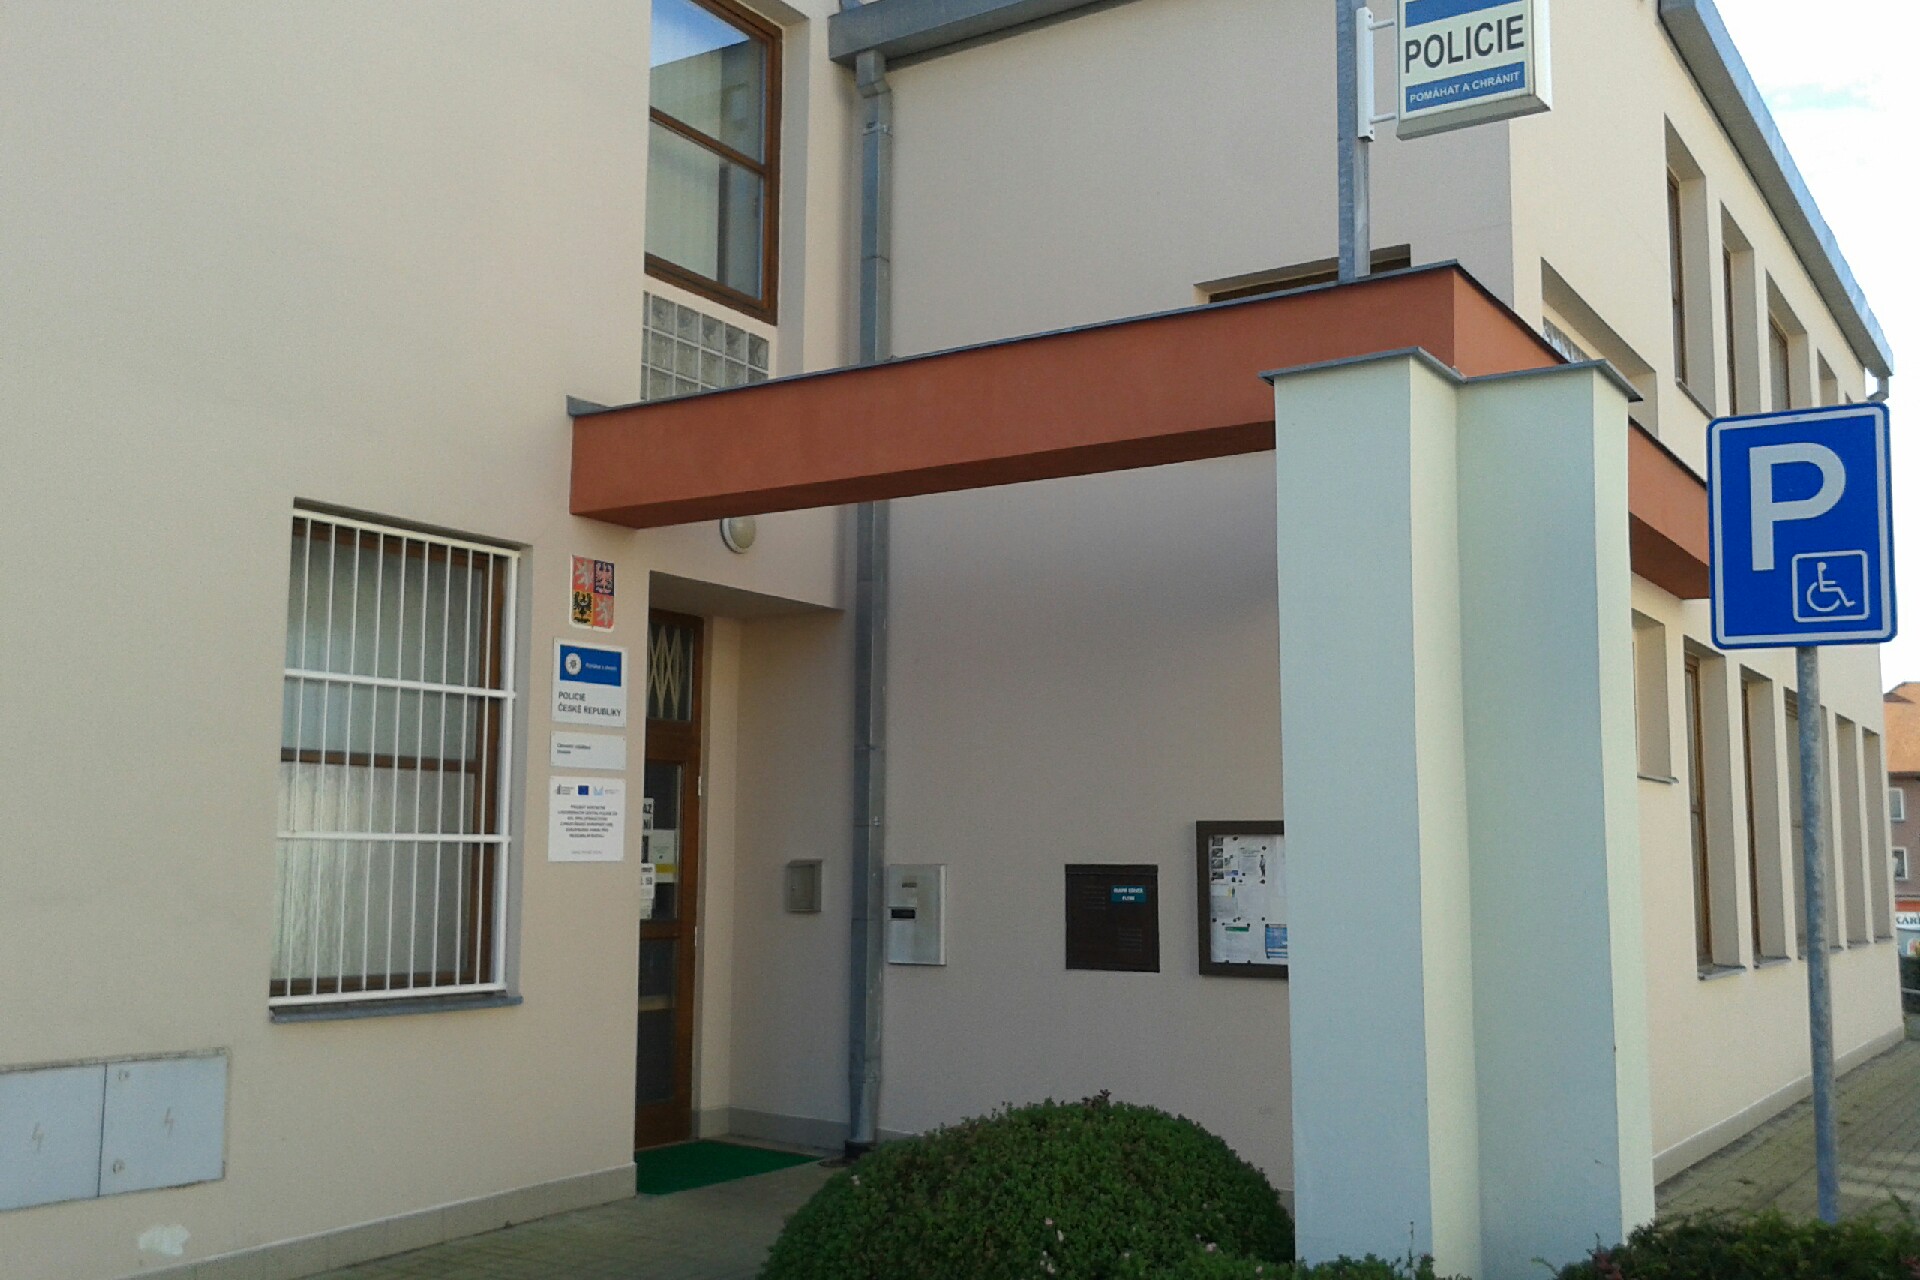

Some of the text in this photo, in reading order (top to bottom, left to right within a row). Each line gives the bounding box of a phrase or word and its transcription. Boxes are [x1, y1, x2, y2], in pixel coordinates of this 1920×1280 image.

[1405, 13, 1525, 73] POLICIE
[1409, 71, 1521, 103] POMÁHAT A CHRÁNIT
[1749, 442, 1847, 571] P
[558, 691, 586, 702] POLICIE
[583, 705, 622, 717] REPUBLIKY
